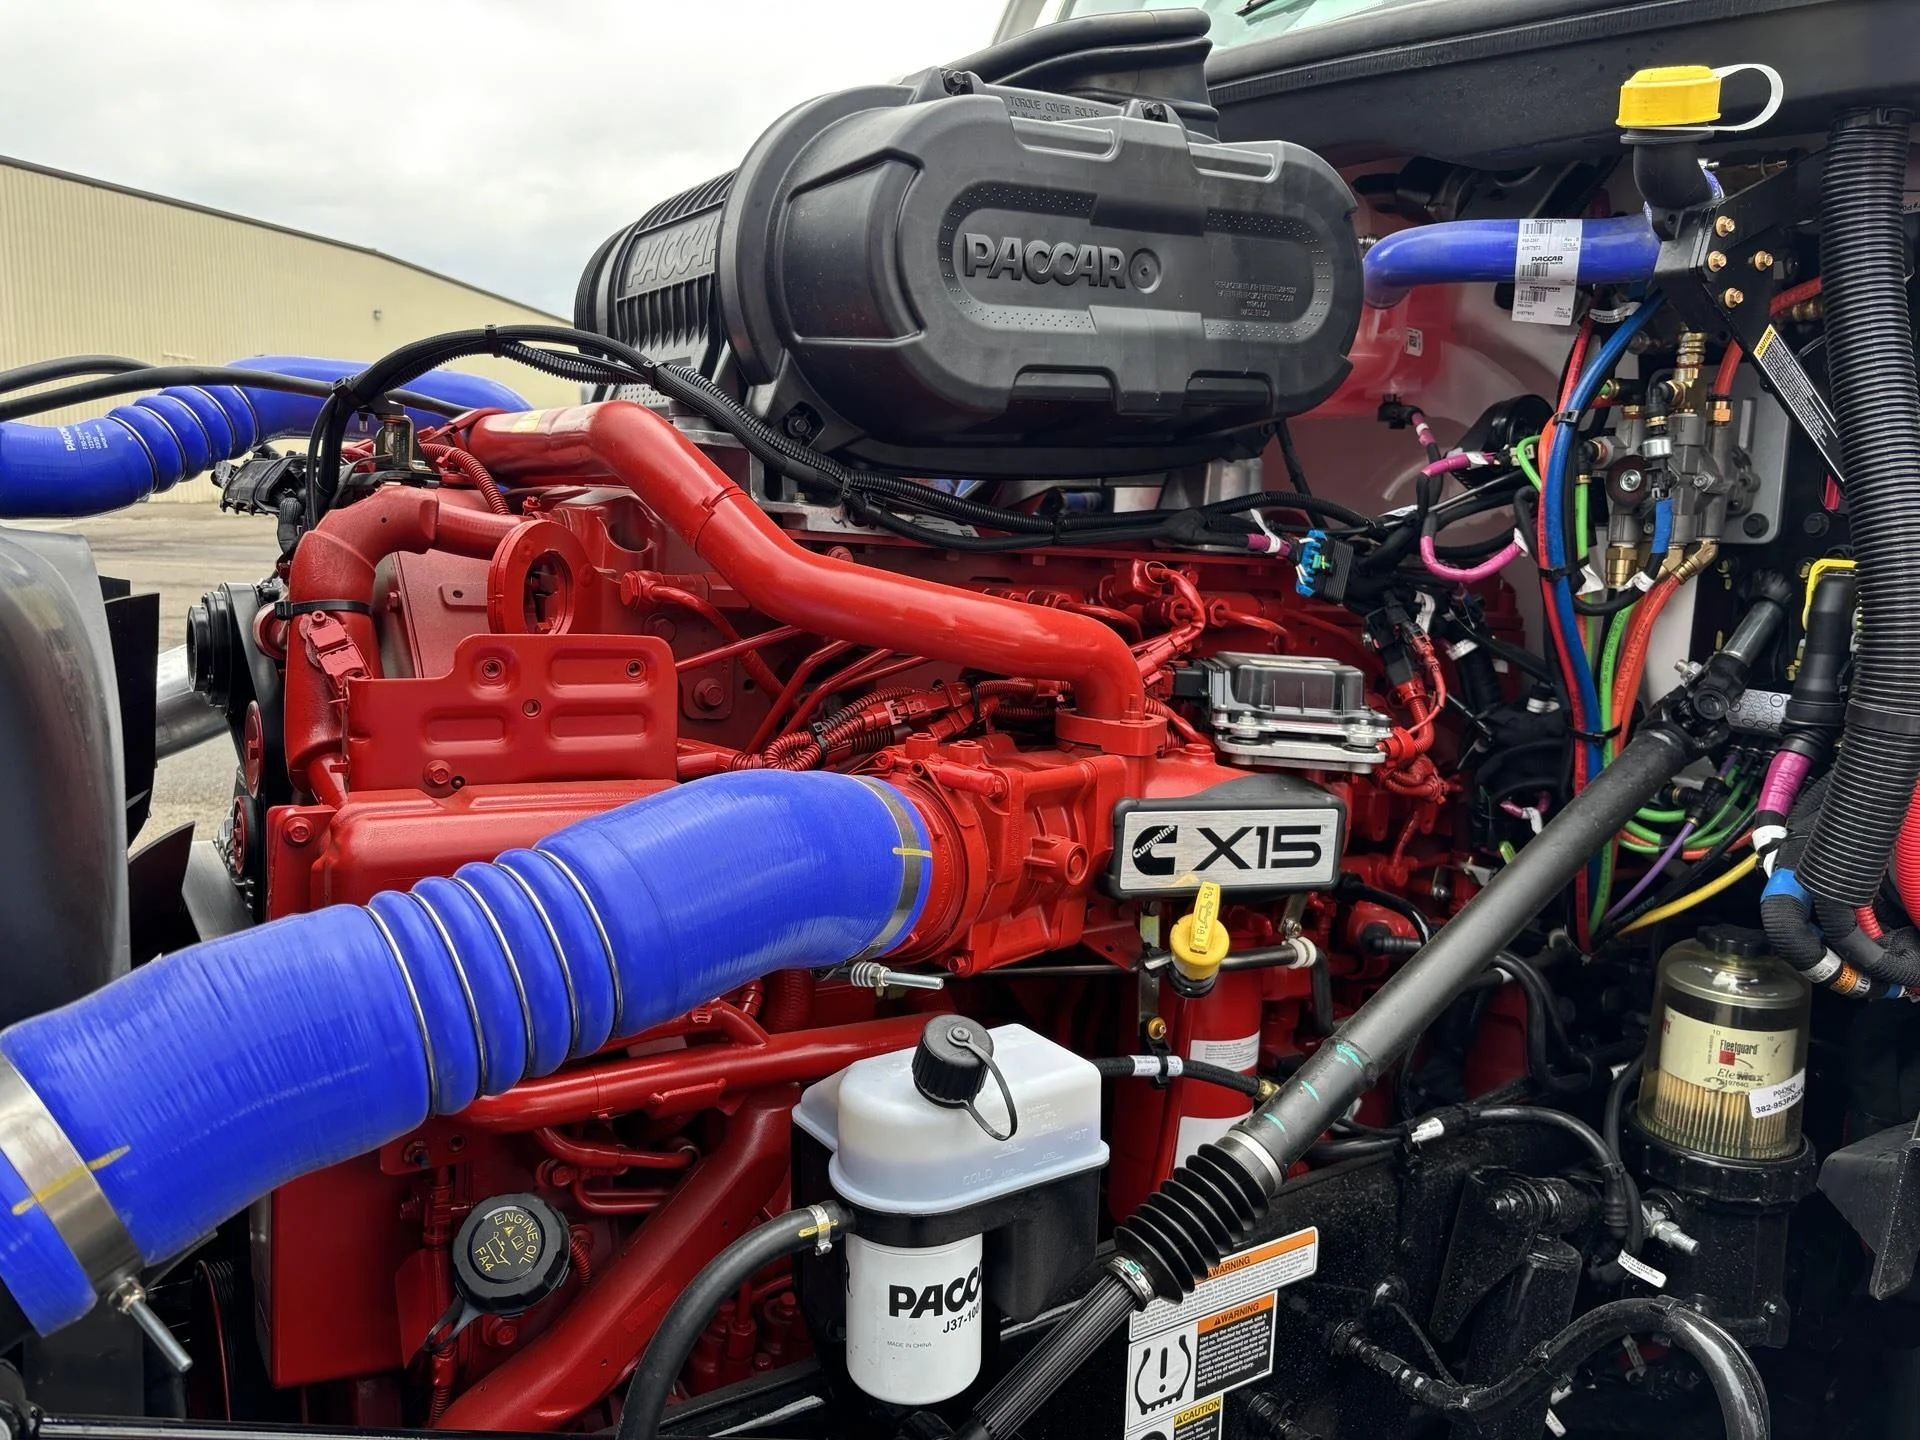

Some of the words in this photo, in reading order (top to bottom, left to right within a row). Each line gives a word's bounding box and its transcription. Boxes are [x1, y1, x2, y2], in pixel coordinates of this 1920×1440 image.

[1009, 96, 1040, 110] TORQUE
[1045, 102, 1071, 115] COVER
[1075, 106, 1101, 118] BOLTS
[494, 212, 539, 242] ENGINE
[518, 245, 537, 264] OIL
[474, 246, 494, 272] FA4
[964, 233, 1126, 289] PACCAR
[1756, 330, 1773, 356] CAUTION
[1132, 824, 1176, 859] Cummins
[1192, 825, 1322, 872] X15
[1720, 1039, 1758, 1056] Fleetguard
[1211, 1256, 1250, 1276] WARNING
[1219, 1302, 1259, 1324] WARNING
[1182, 1400, 1220, 1422] CAUTION
